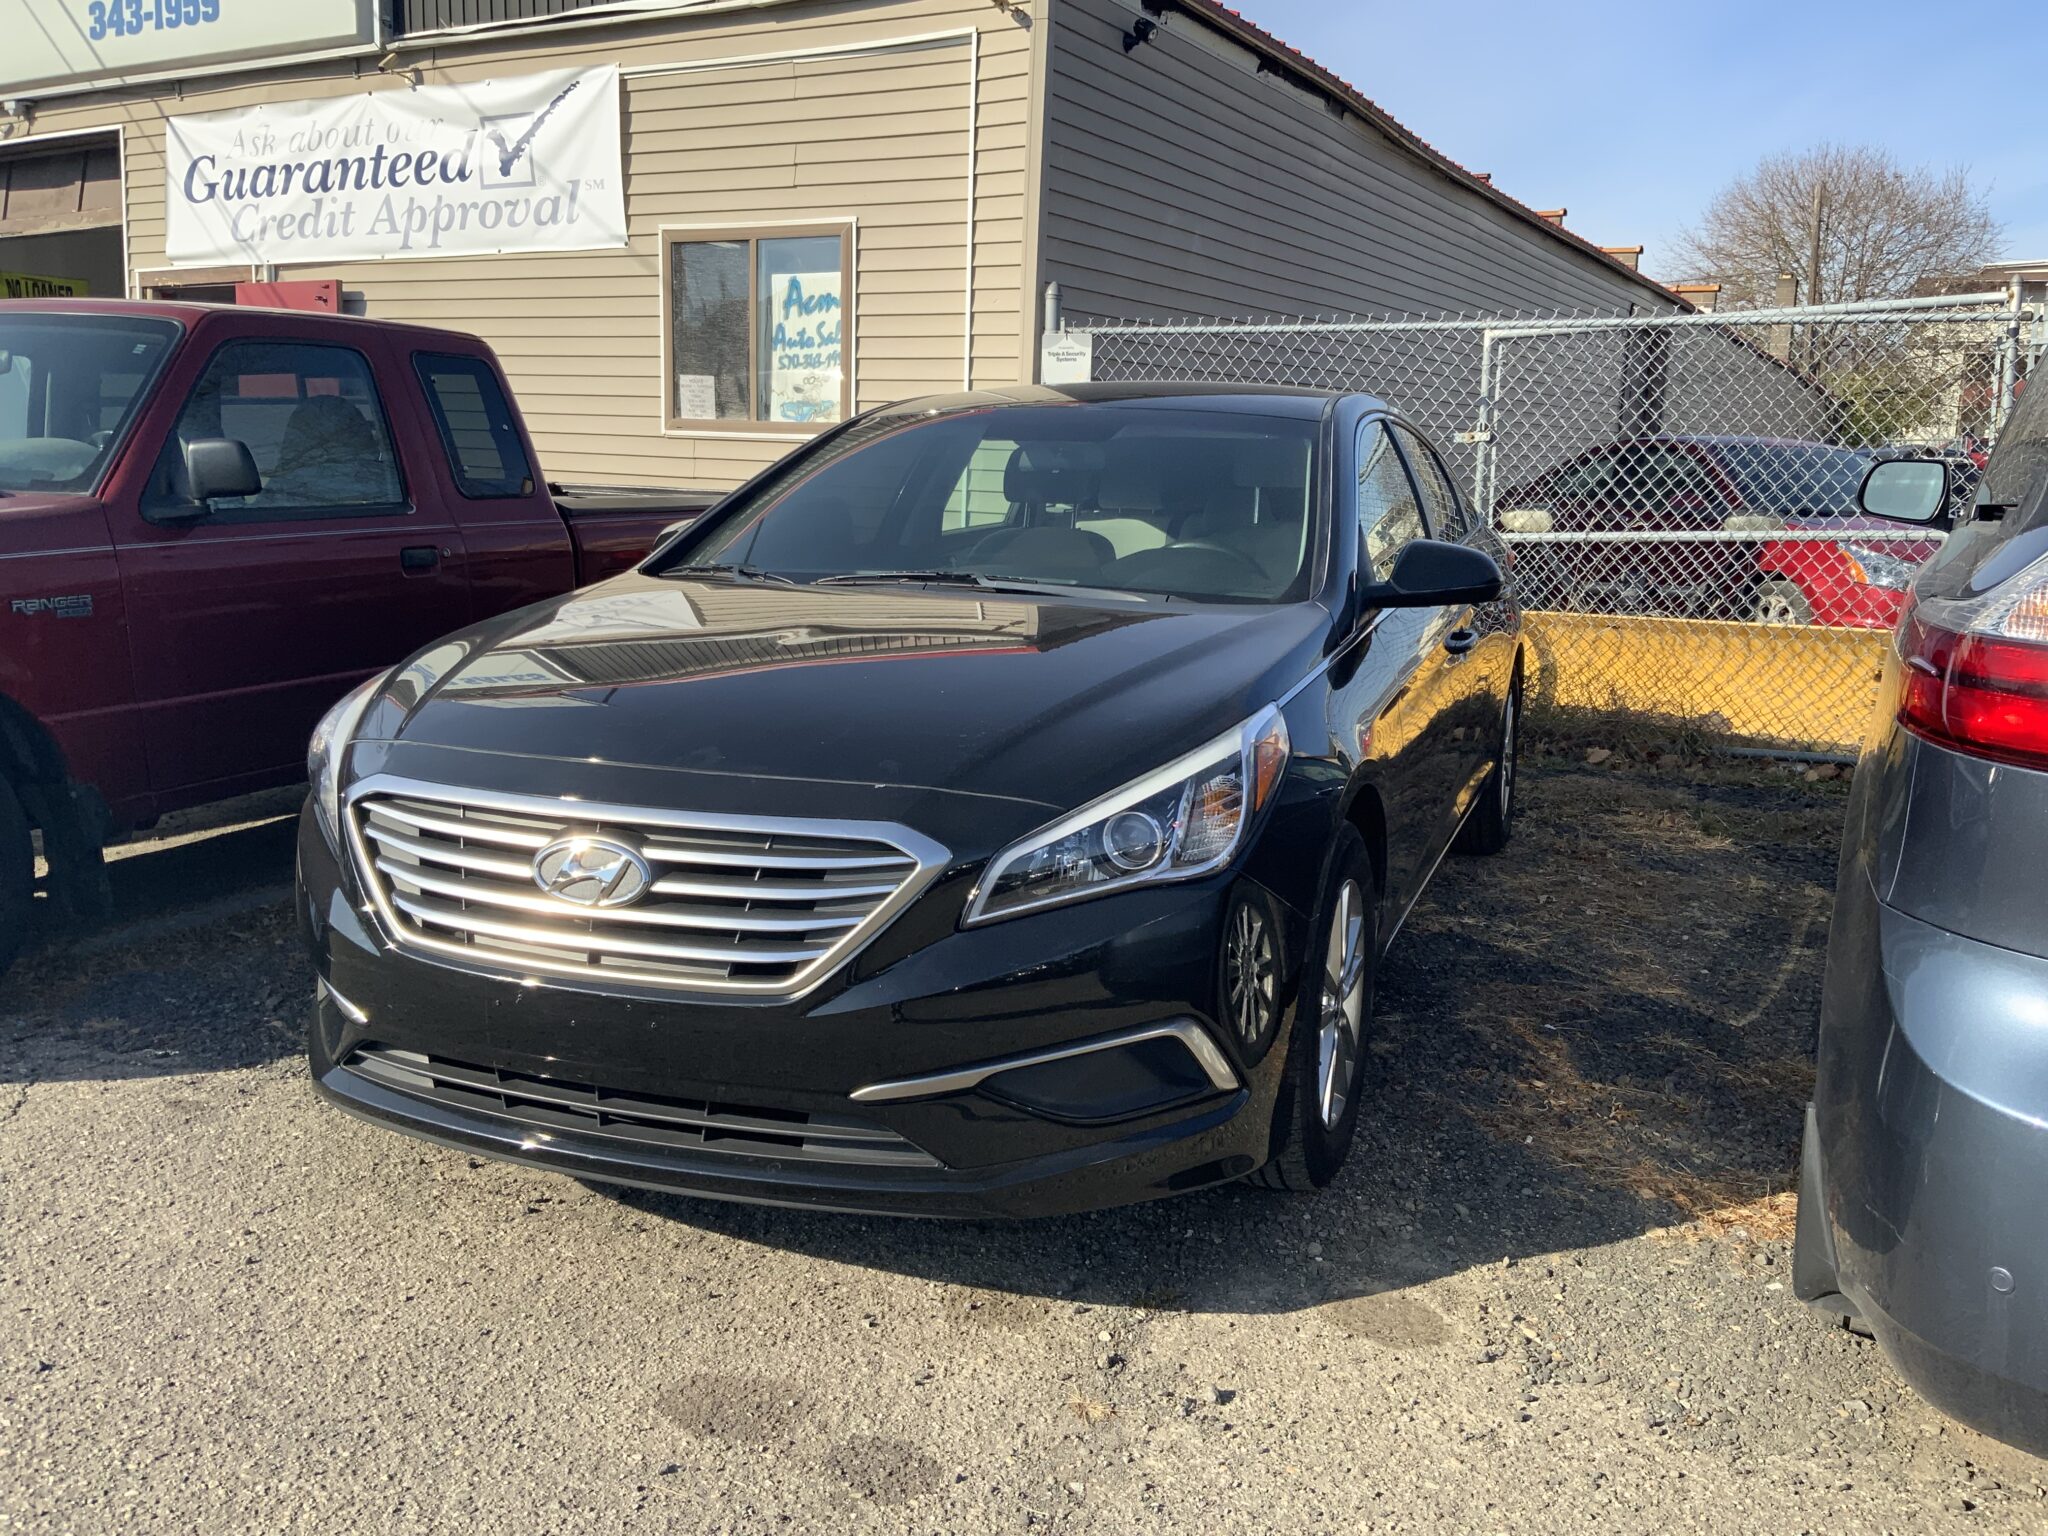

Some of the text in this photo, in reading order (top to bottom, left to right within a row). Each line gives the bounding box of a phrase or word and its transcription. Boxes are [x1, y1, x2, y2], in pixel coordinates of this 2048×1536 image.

[226, 117, 444, 159] Ask about our
[183, 129, 479, 204] Guaranteed
[231, 178, 605, 250] Credit Approval SM
[772, 323, 815, 352] Auto
[11, 594, 92, 615] RANGER
